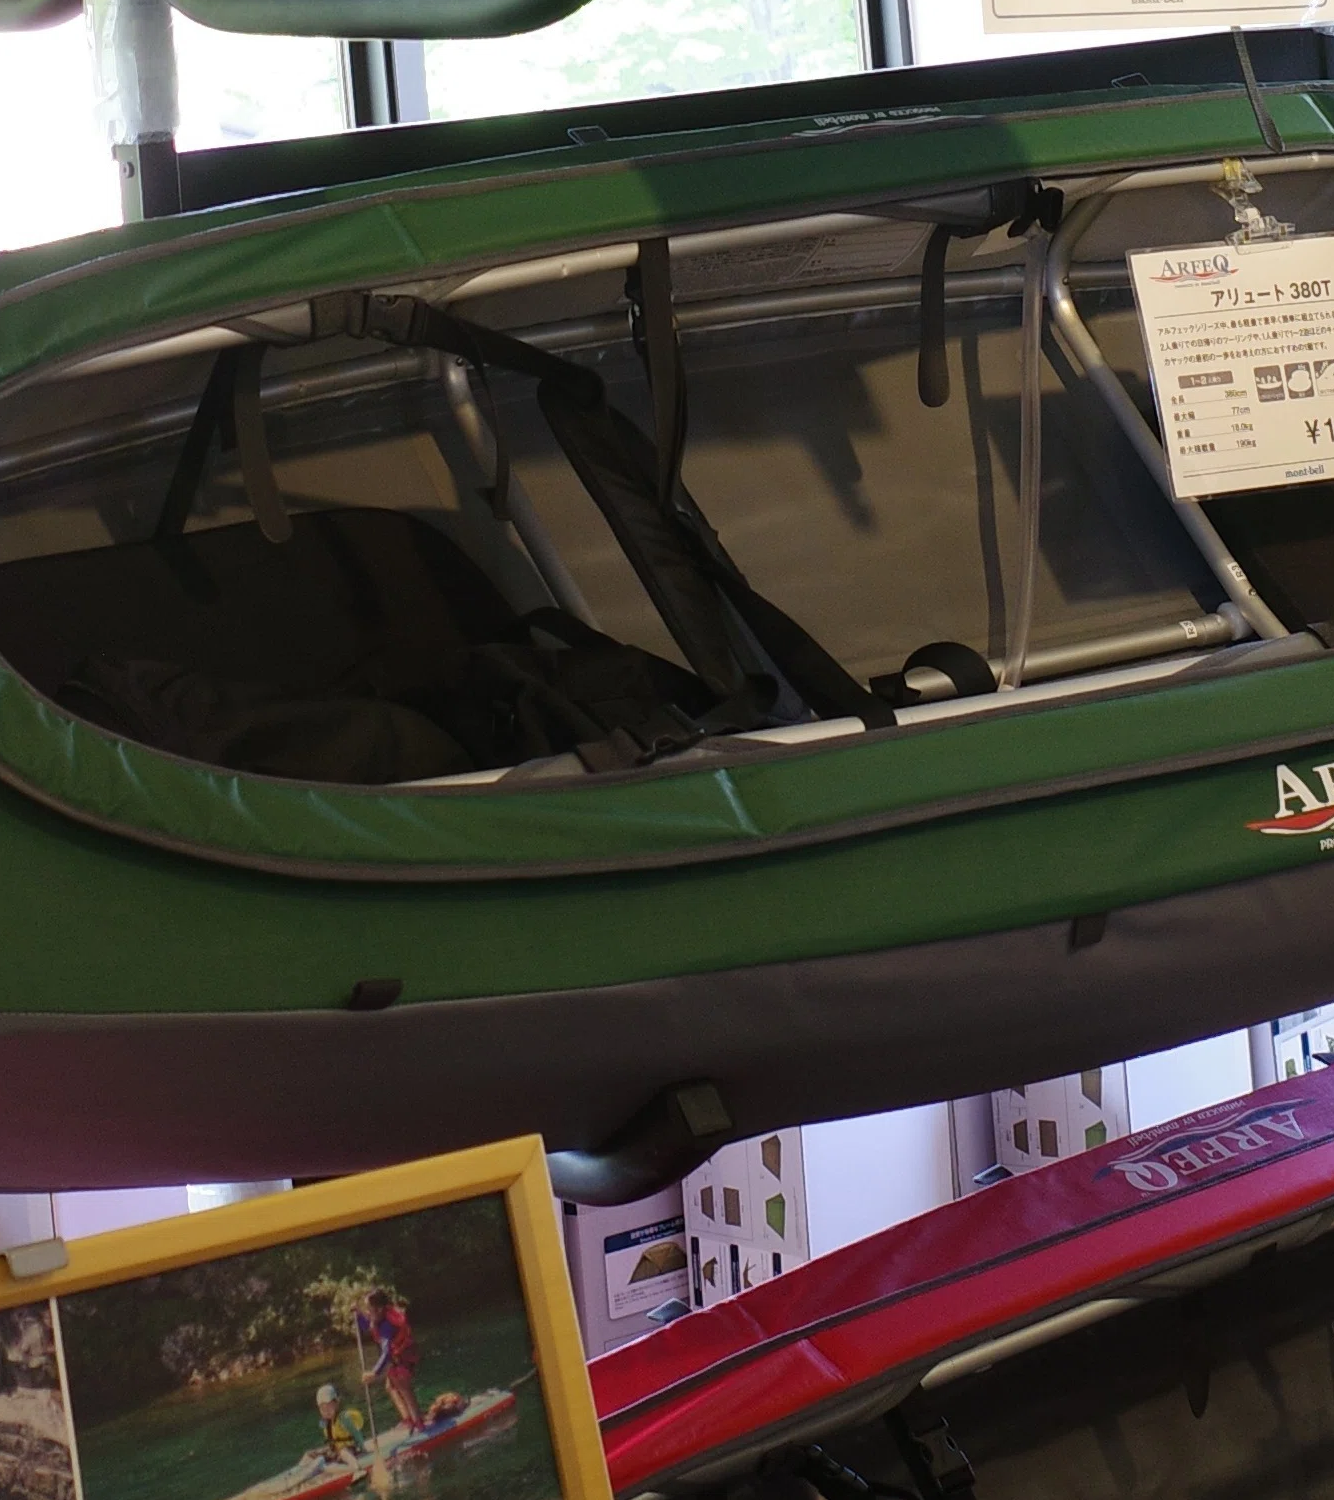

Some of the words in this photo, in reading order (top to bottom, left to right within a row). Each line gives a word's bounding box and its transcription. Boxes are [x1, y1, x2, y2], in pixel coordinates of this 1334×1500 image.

[1161, 253, 1230, 277] ARFEQ
[1211, 284, 1284, 307] アリュート
[1290, 280, 1331, 300] 380T
[1231, 406, 1250, 415] 77cm
[1114, 1109, 1305, 1191] ARFEQ
